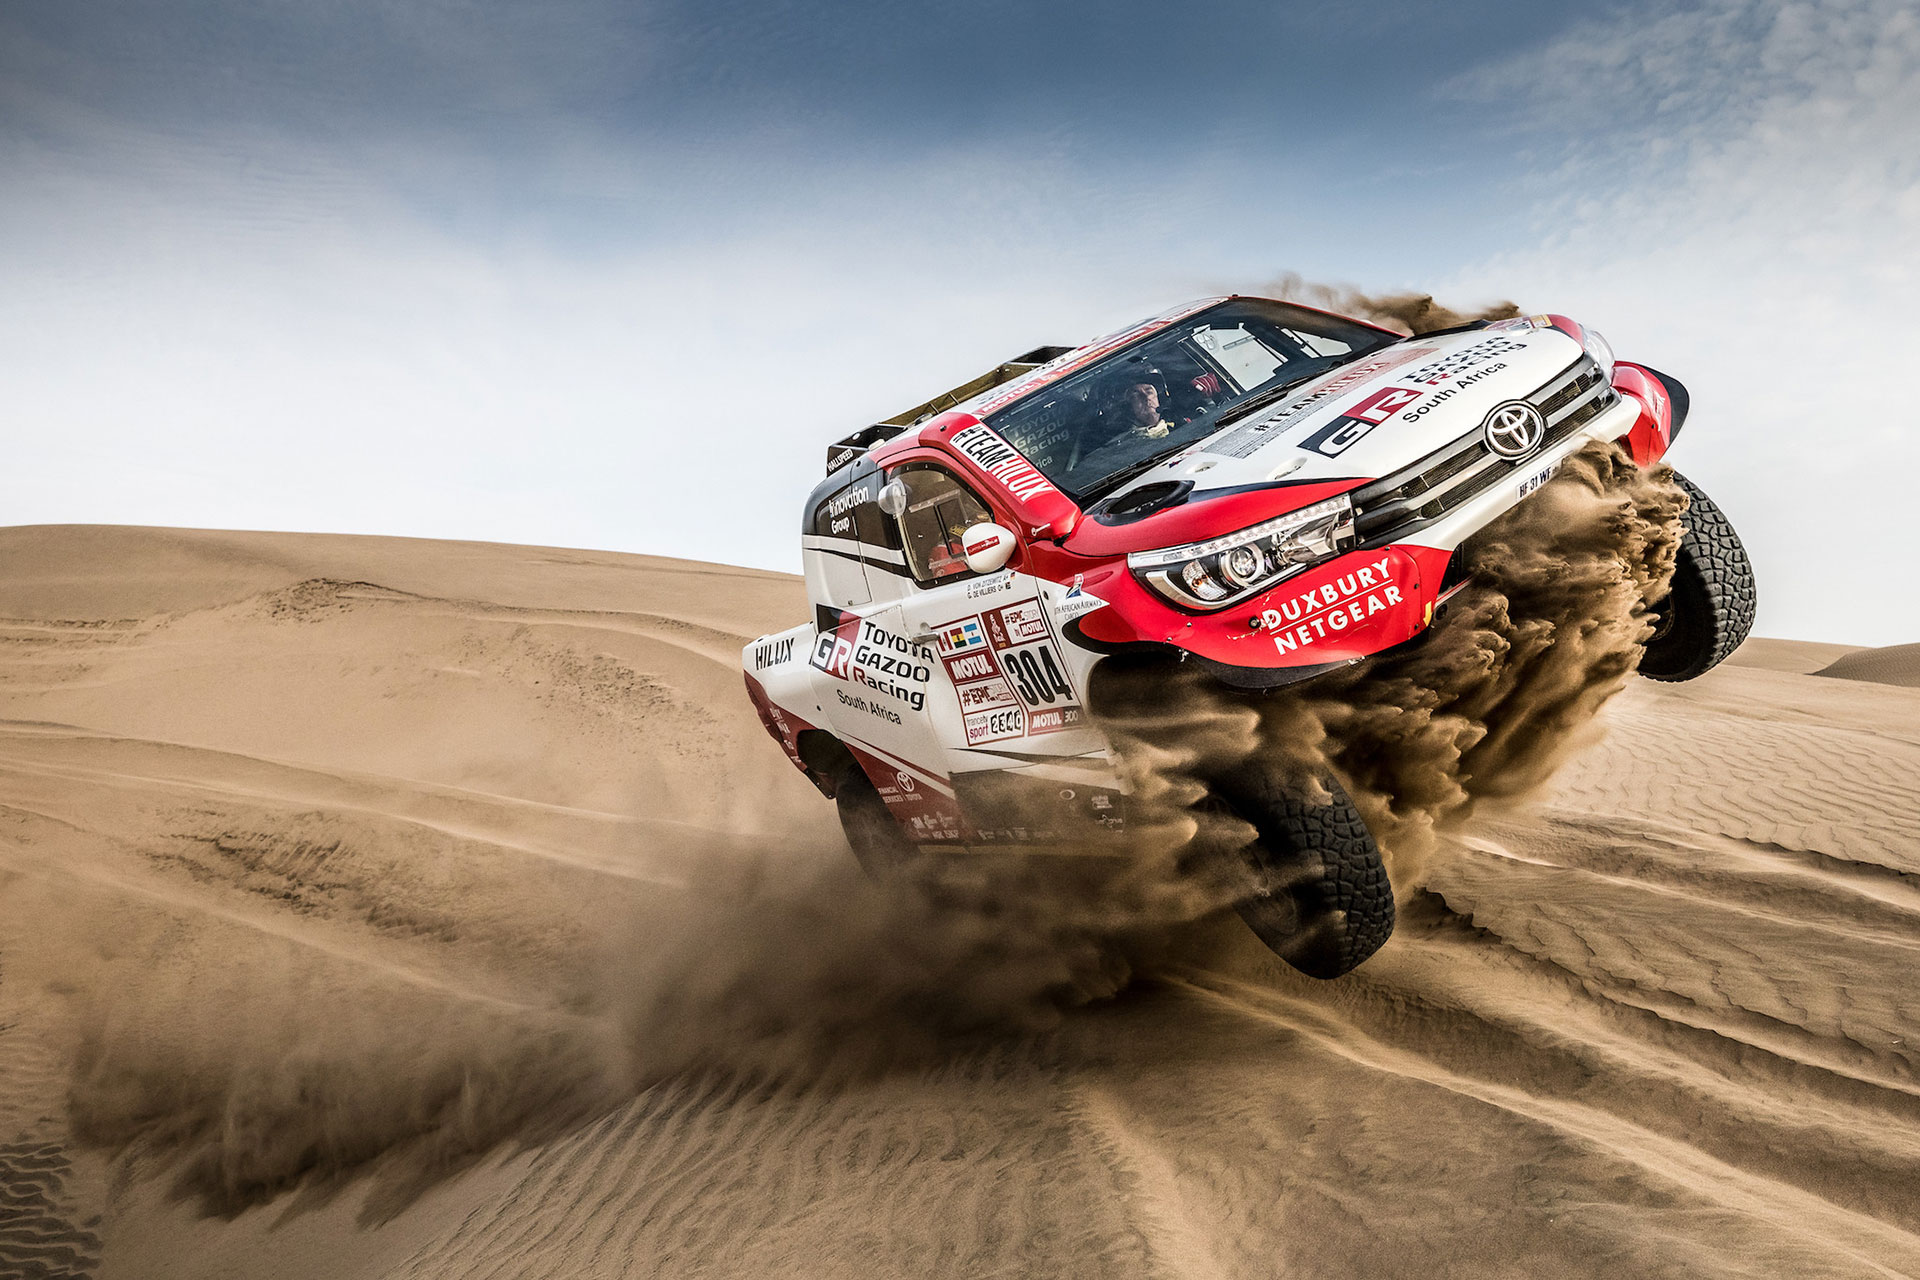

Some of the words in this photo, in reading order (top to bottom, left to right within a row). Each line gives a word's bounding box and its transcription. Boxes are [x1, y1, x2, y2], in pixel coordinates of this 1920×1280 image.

[1397, 337, 1506, 382] TOYOTA
[1413, 341, 1511, 383] GAZOO
[1425, 343, 1528, 385] Racing
[983, 383, 1036, 413] MOTUL
[1402, 389, 1457, 424] South
[1458, 362, 1508, 390] Africa
[1318, 389, 1420, 455] GR
[827, 448, 854, 472] HALLSPEED
[953, 425, 1054, 502] #TEAMHILUX
[1519, 482, 1528, 498] HF
[831, 517, 850, 534] Group
[1261, 558, 1390, 631] DUXBURY
[1020, 620, 1044, 636] MOTUL
[1273, 586, 1404, 656] NETGEAR
[812, 631, 853, 681] GR
[865, 621, 935, 664] TOYOTA
[855, 645, 931, 683] GAZOO
[951, 654, 994, 680] MOTUL
[1004, 645, 1074, 706] 304
[837, 689, 868, 713] South
[870, 700, 902, 726] Africa
[853, 666, 926, 712] Racing
[970, 723, 989, 741] sport
[1032, 711, 1063, 729] MOTUL
[1064, 710, 1079, 723] 300
